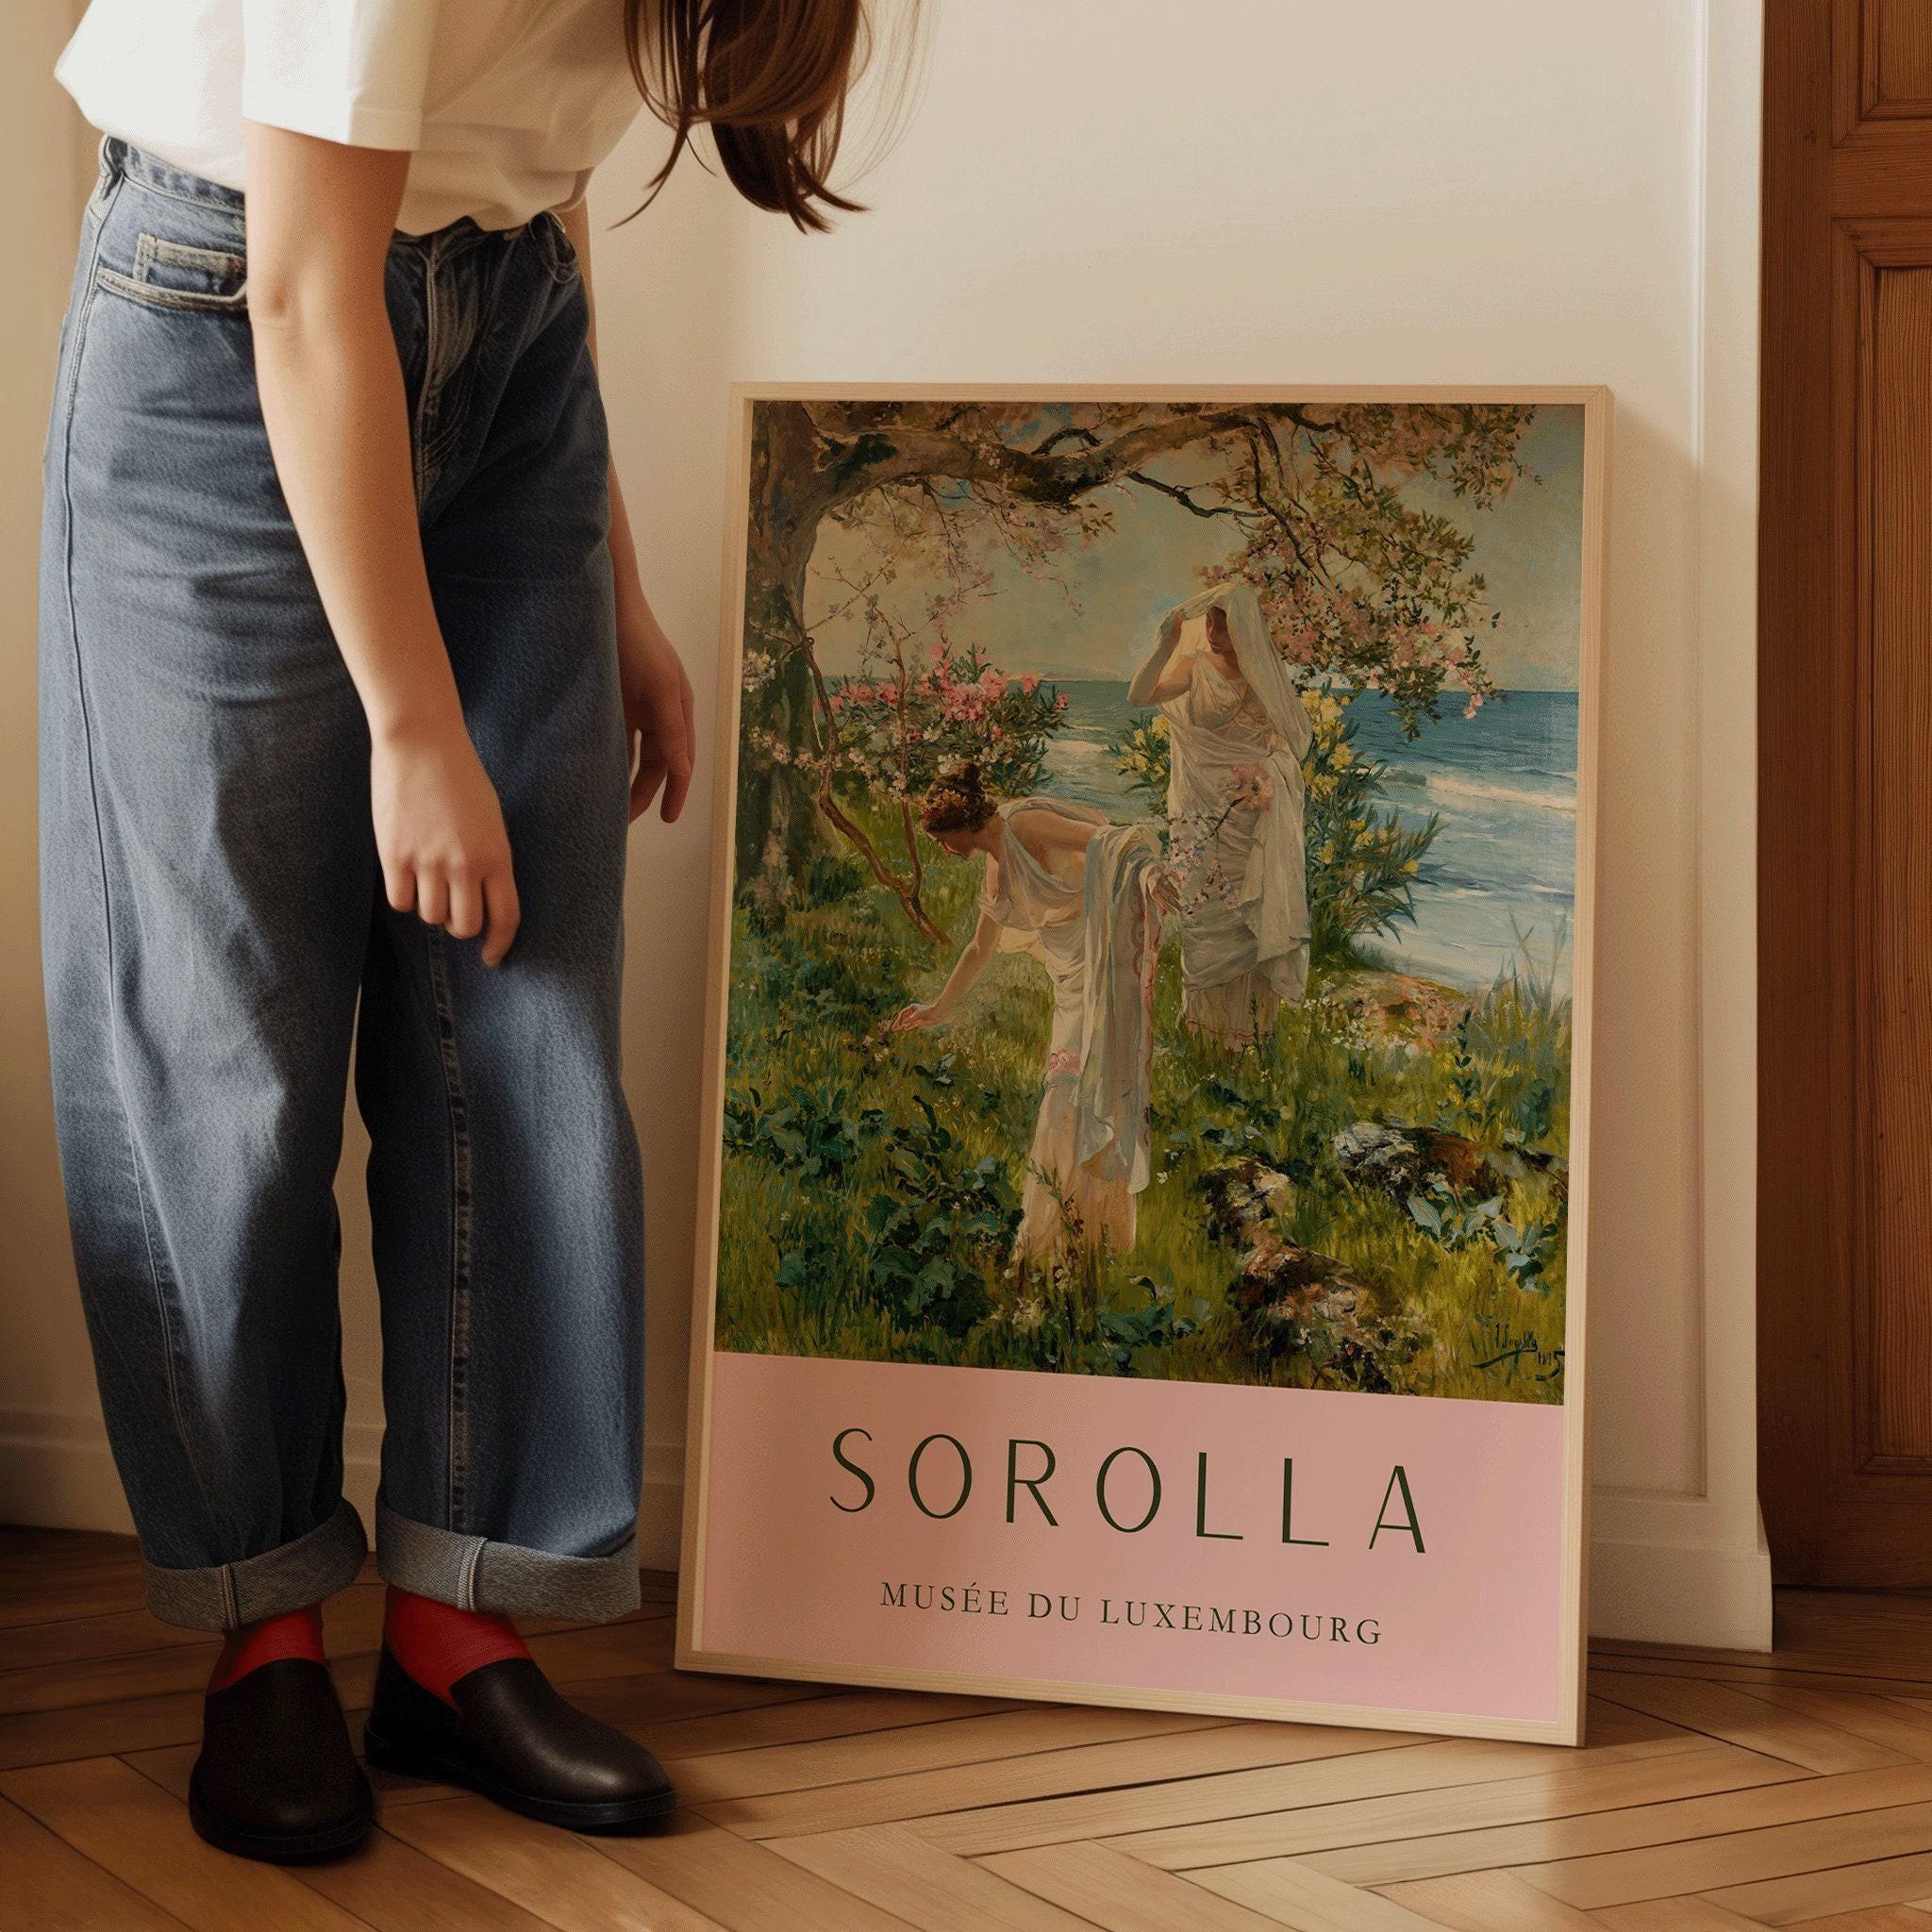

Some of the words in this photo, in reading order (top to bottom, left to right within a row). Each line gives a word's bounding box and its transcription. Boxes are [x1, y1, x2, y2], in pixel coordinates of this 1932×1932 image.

[828, 1427, 1426, 1554] SOROLLA
[879, 1580, 1009, 1616] MUSÉE
[1026, 1592, 1081, 1622] DU
[1100, 1598, 1382, 1645] LUXEMBOURG
